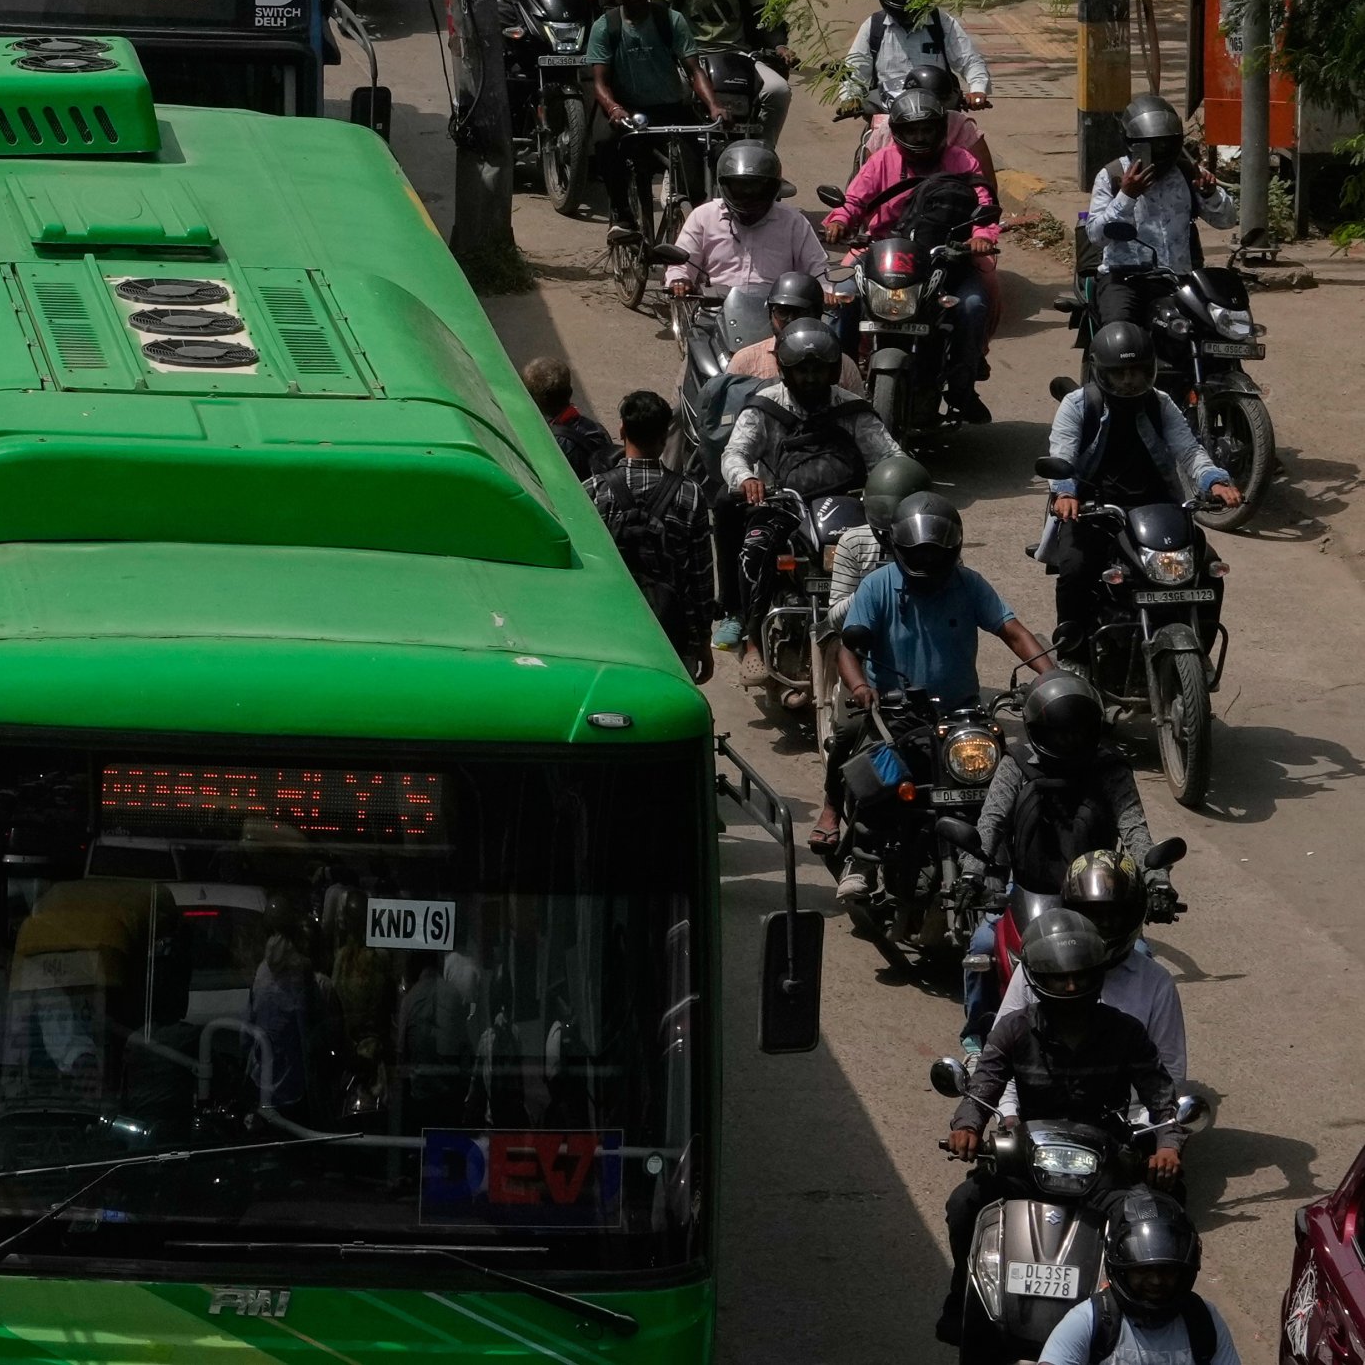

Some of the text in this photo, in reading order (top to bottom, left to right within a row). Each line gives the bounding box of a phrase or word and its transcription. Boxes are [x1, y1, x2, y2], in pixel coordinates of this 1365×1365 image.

[255, 8, 301, 18] SWITCH
[371, 906, 451, 945] KND (S)
